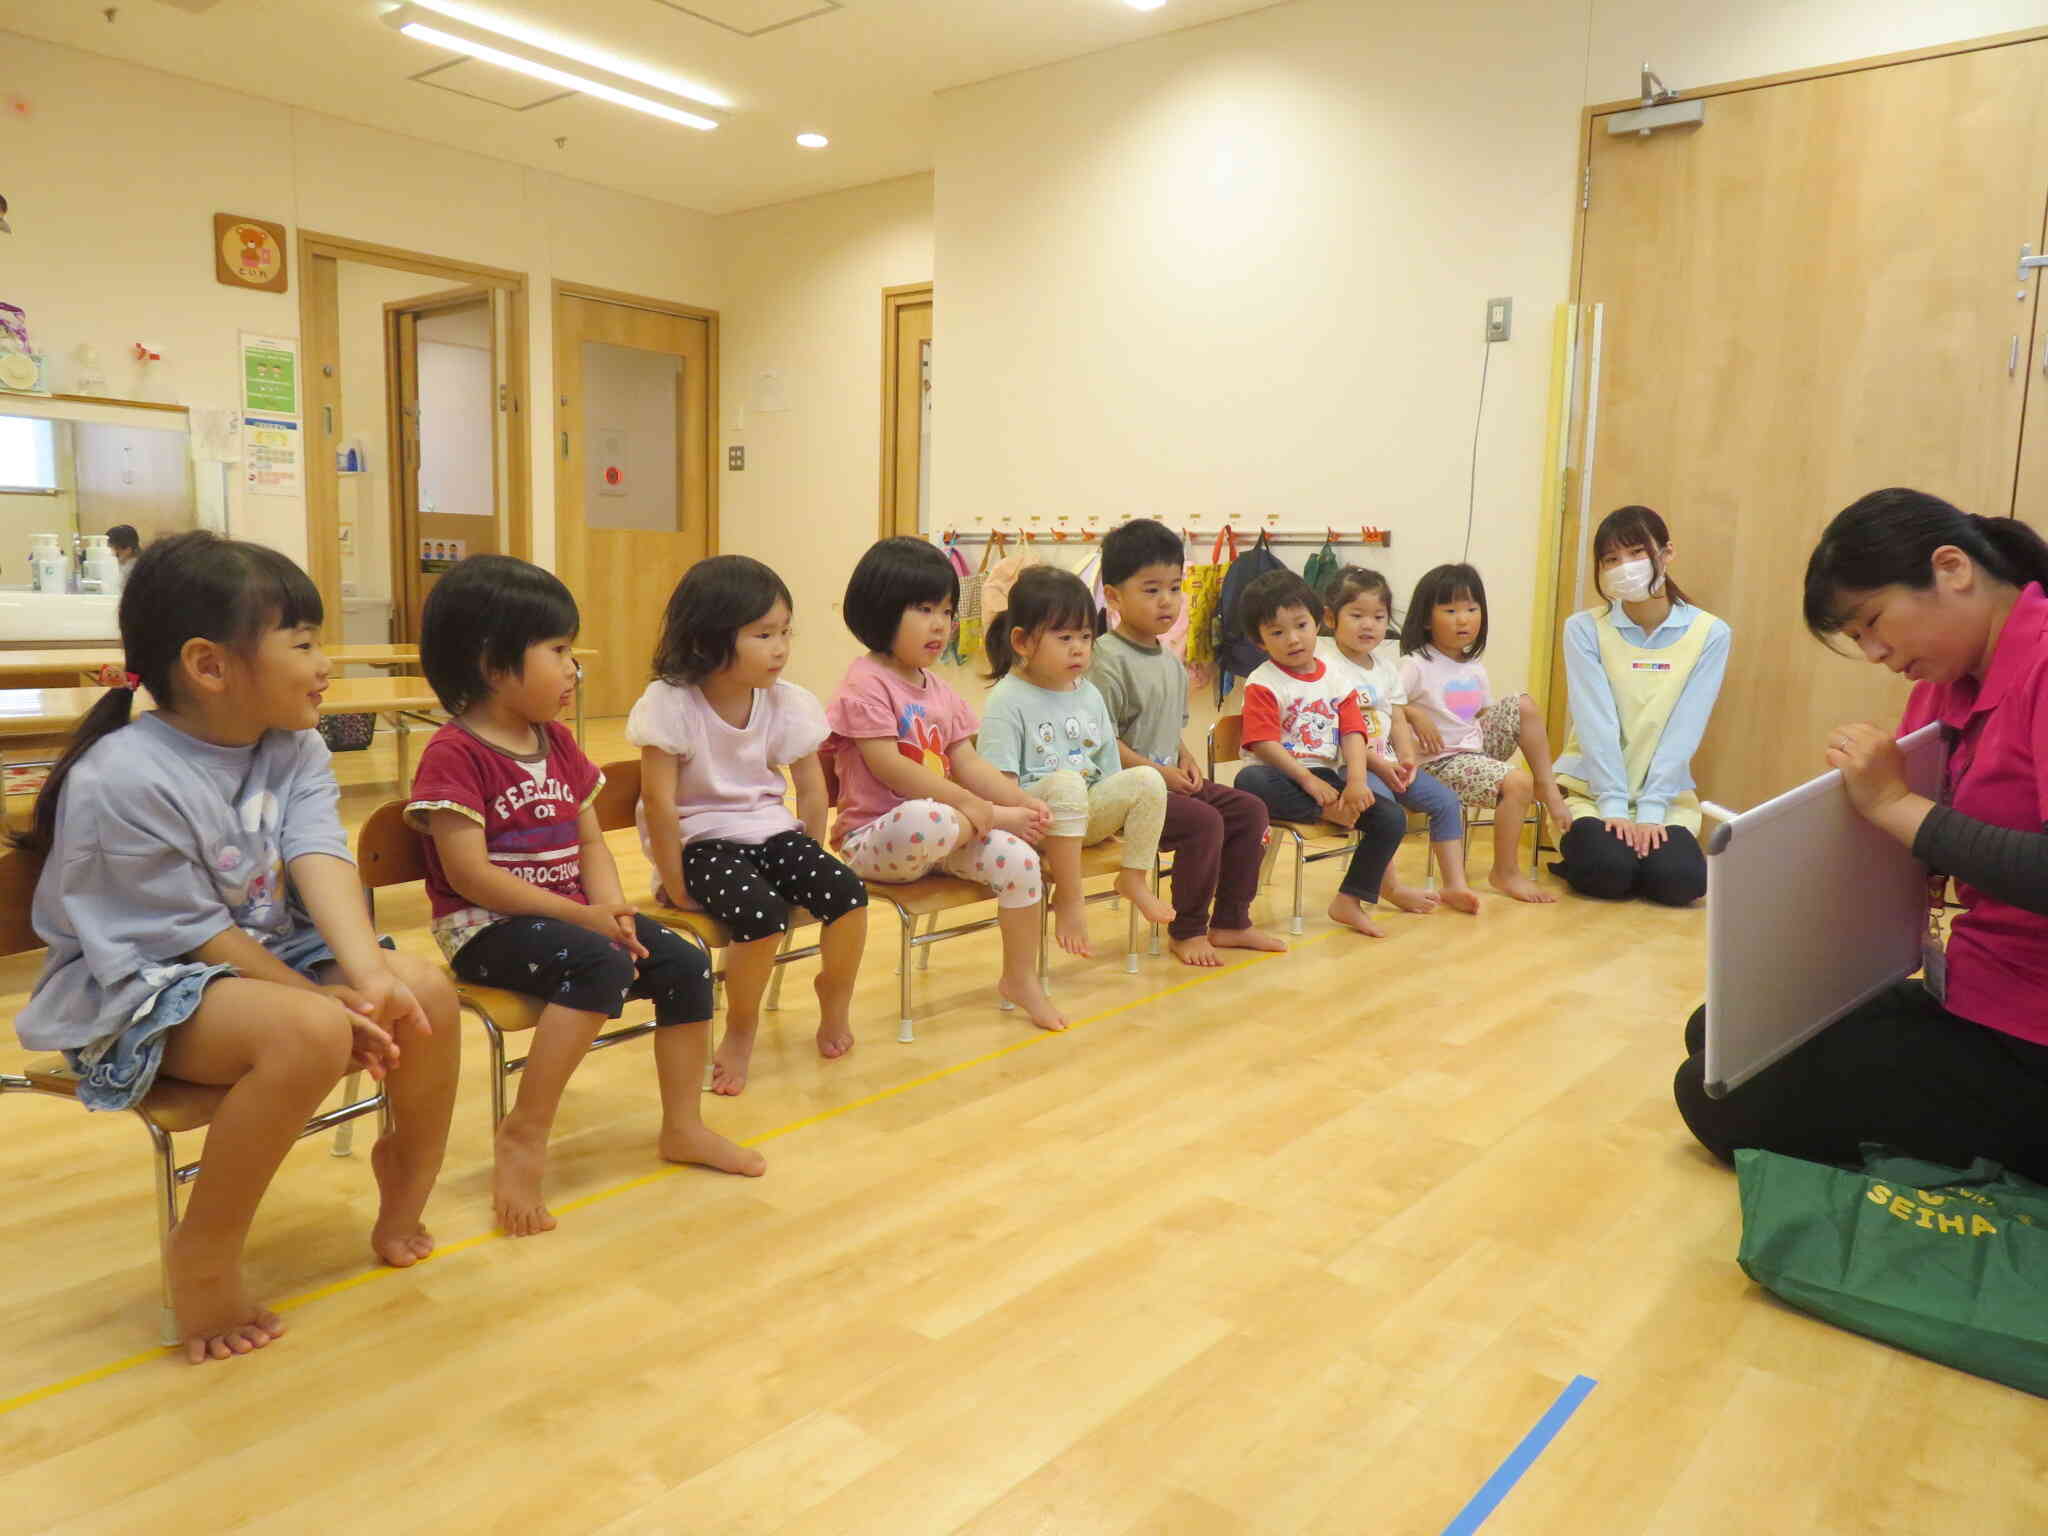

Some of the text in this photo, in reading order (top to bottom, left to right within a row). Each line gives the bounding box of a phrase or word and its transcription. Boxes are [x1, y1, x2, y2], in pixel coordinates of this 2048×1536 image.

[495, 778, 575, 820] FEELING
[534, 803, 557, 819] OF
[1866, 1184, 1997, 1236] SEIHA
